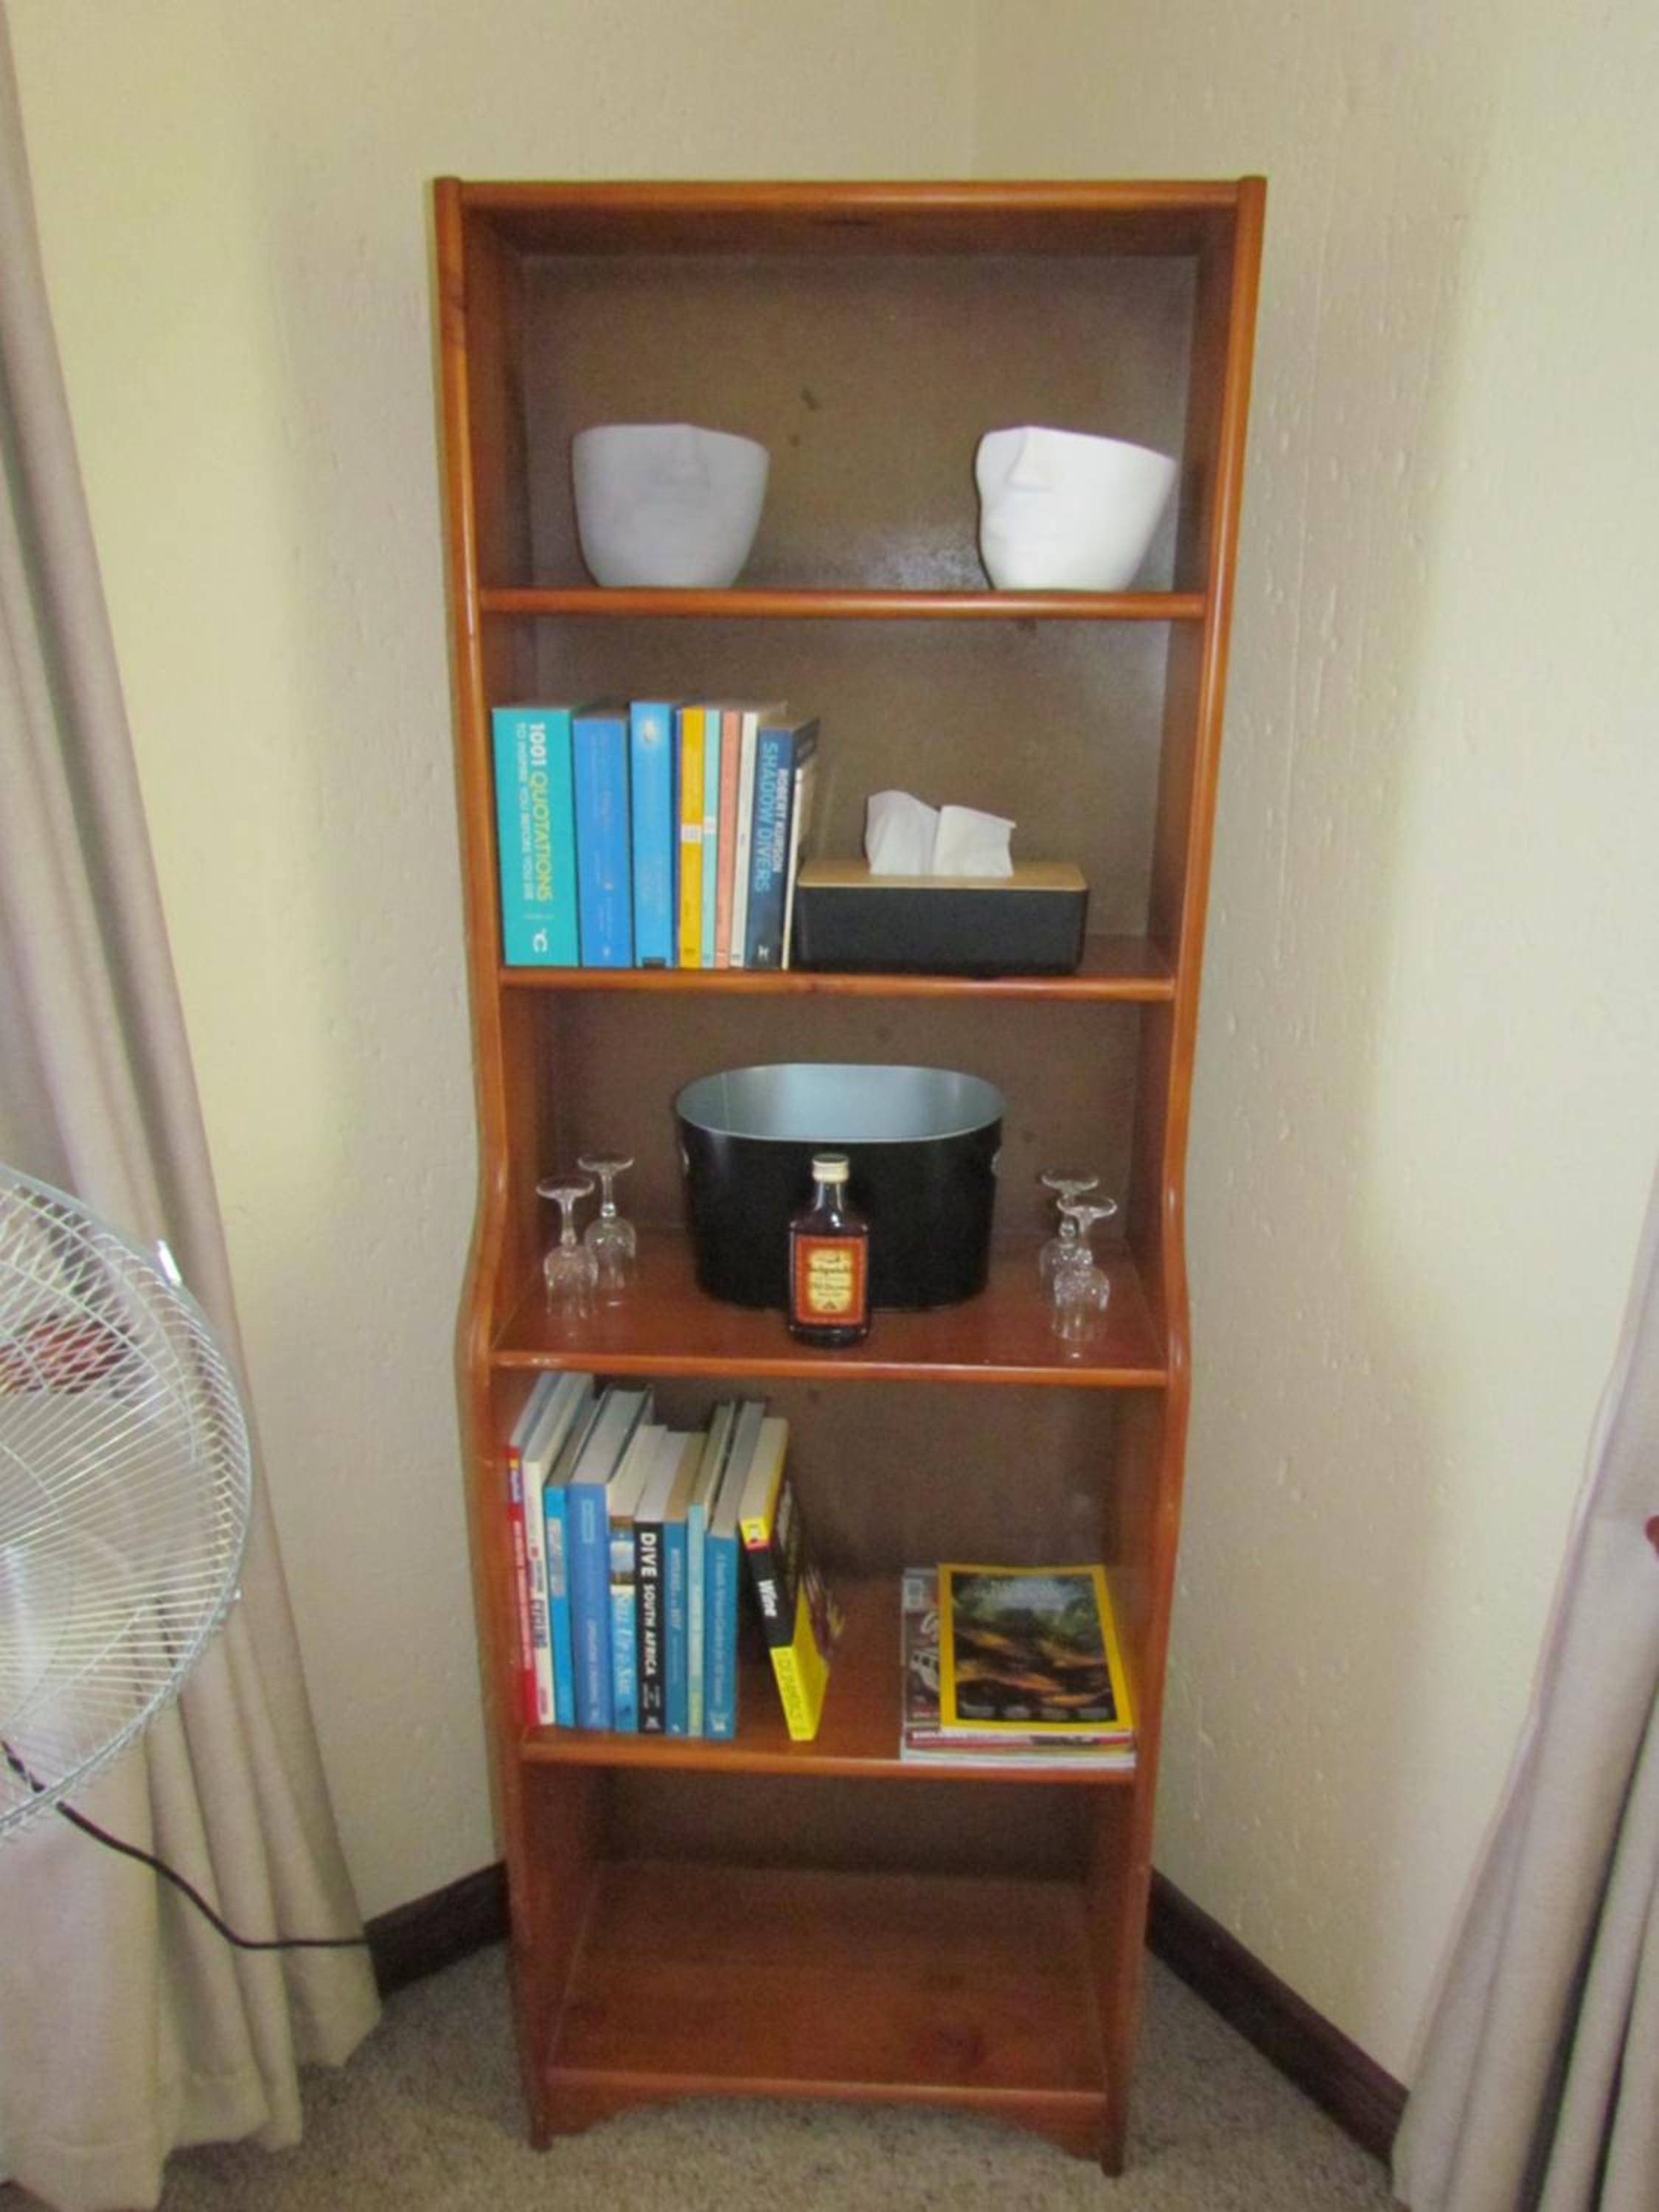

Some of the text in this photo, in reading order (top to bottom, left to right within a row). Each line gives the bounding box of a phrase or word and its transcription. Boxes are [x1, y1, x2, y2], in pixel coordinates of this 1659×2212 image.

[529, 723, 552, 902] 1001 QUOTATIONS
[775, 768, 789, 818] ROBERT
[754, 742, 779, 894] SHADOW DIVERS
[639, 1532, 658, 1578] DIVE
[642, 1584, 658, 1627] SOUTH
[757, 1579, 779, 1617] Wine
[643, 1630, 658, 1676] AFRICA
